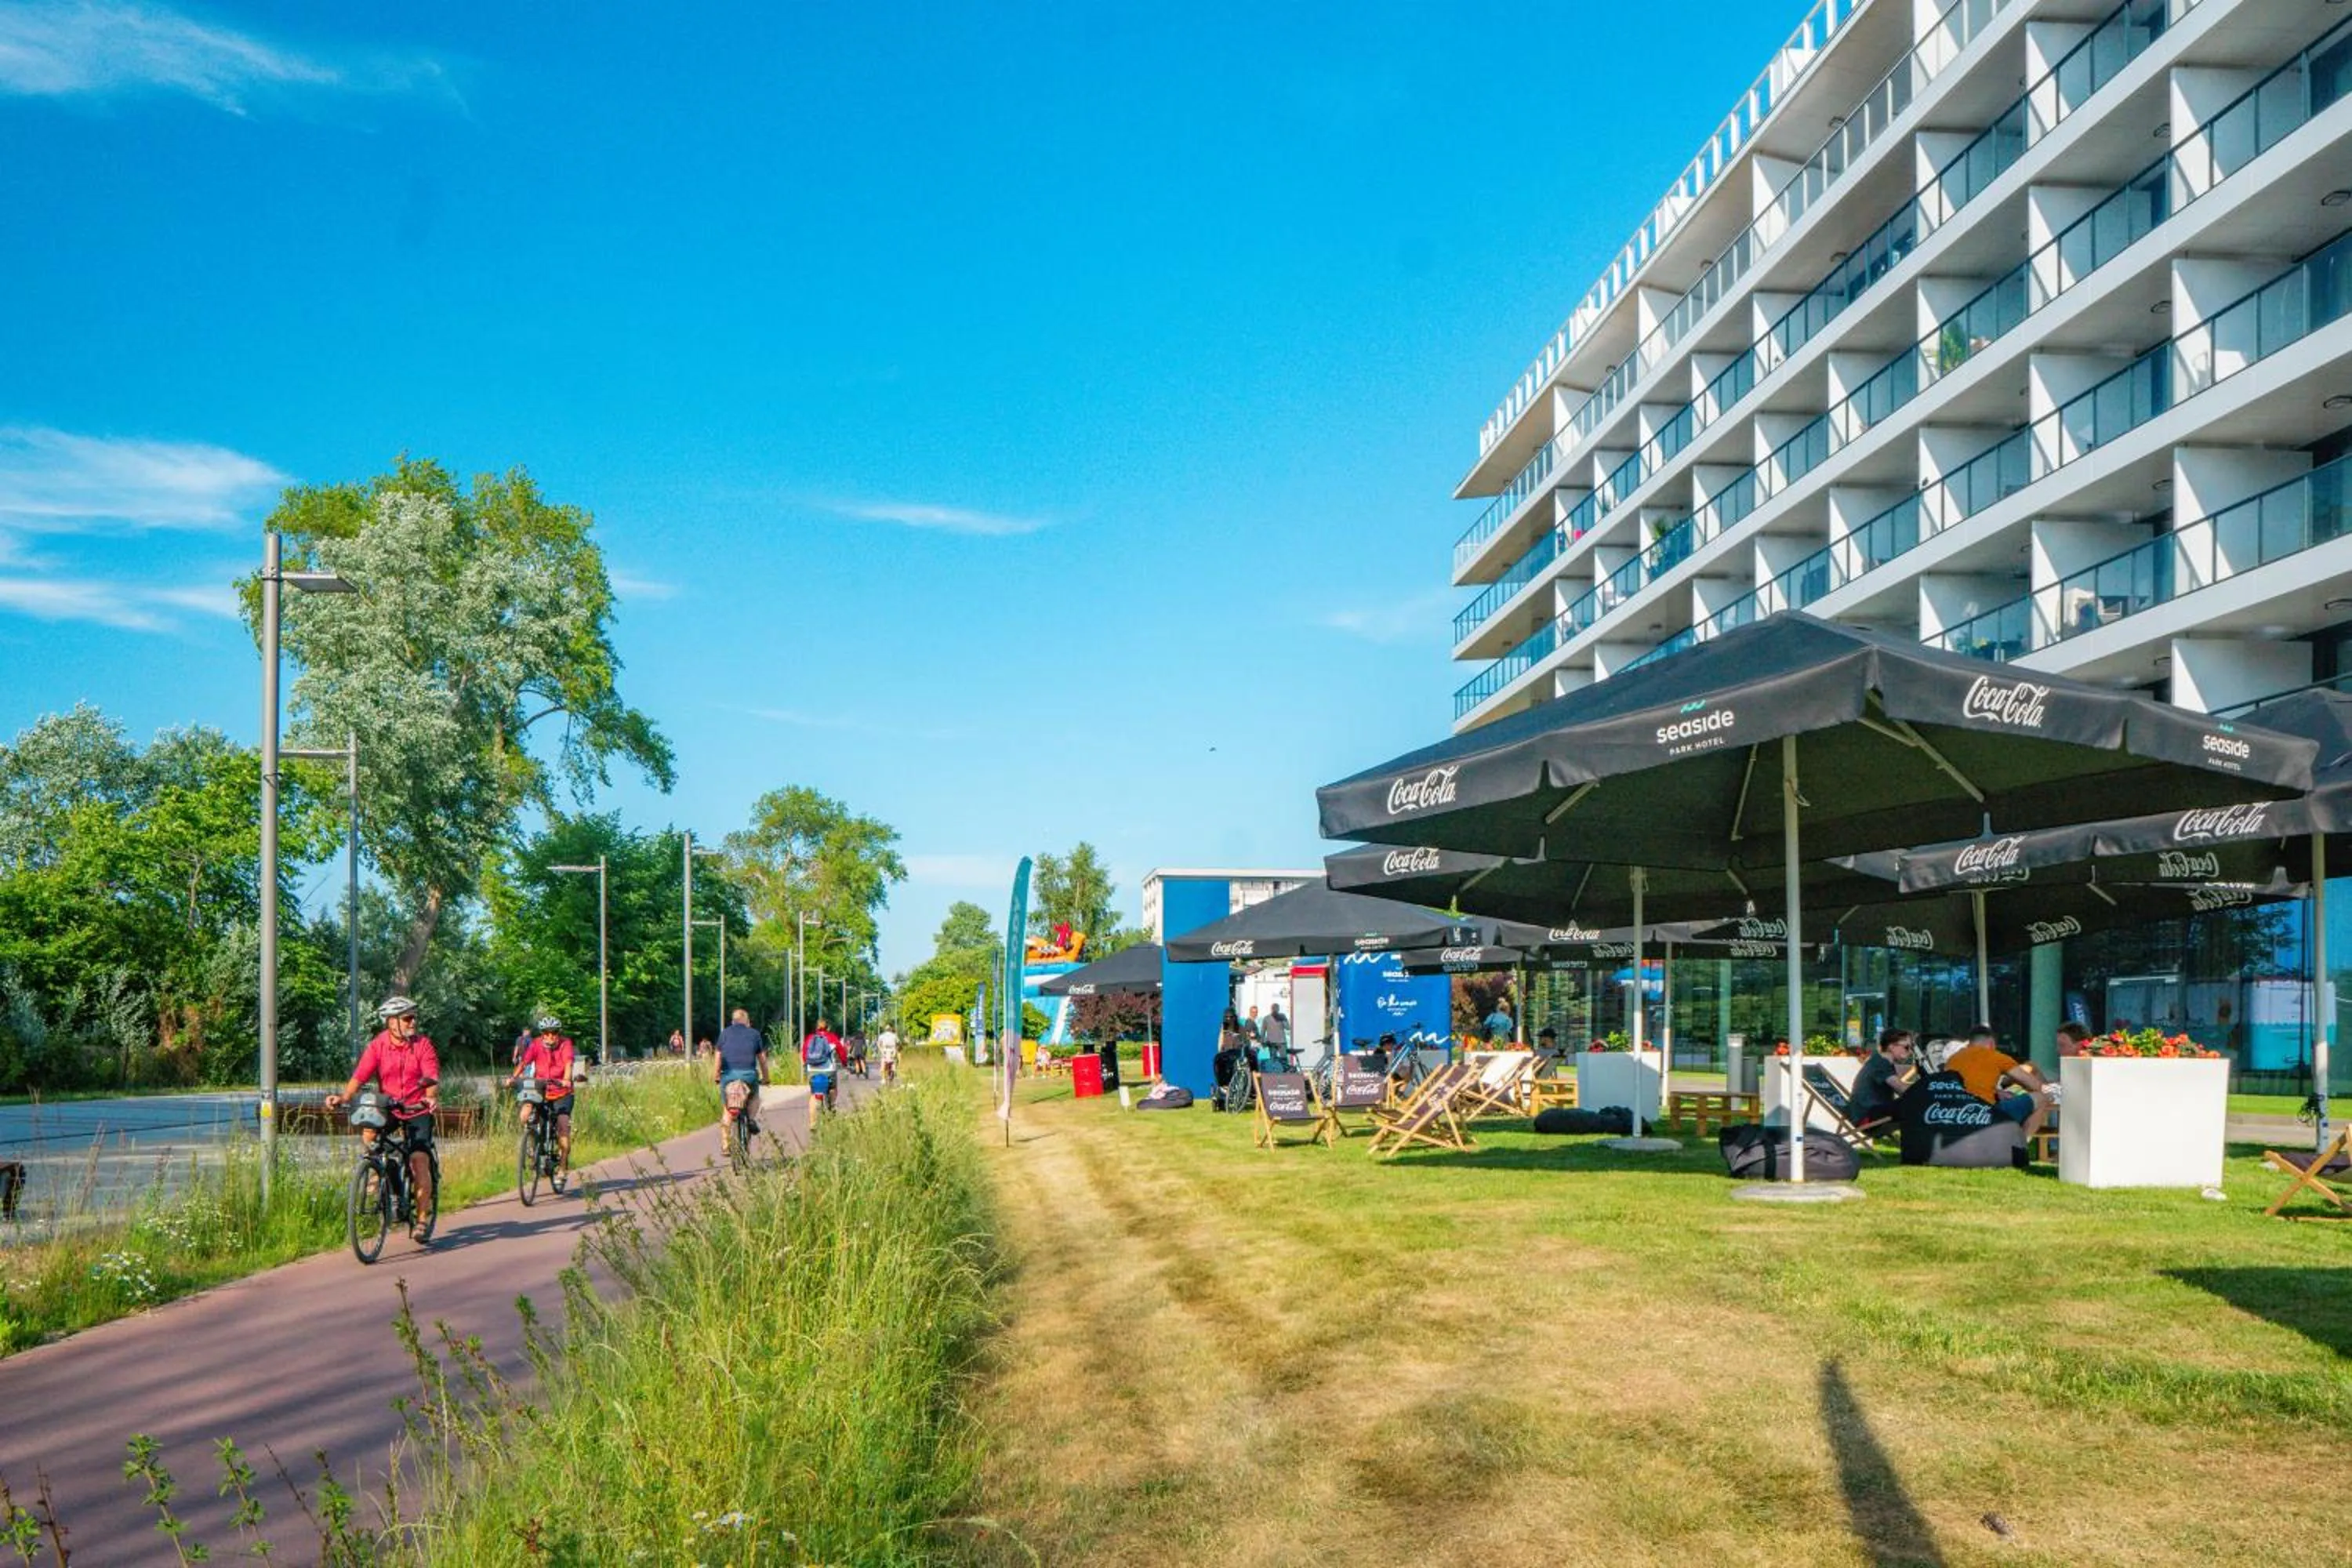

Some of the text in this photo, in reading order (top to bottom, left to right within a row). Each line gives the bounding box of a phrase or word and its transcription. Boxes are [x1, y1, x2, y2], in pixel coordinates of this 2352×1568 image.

[1963, 676, 2051, 728] Coca-Cola
[1657, 710, 1734, 743] seaside
[1669, 736, 1725, 757] PARK HOTEL
[2203, 734, 2250, 759] seaside
[1387, 765, 1459, 815] Coca-Cola
[2173, 801, 2274, 841] Coca-Cola
[1384, 847, 1439, 876] Coca-Cola
[1955, 835, 2027, 875] Coca-Cola
[1211, 940, 1254, 956] Coca-Cola
[1441, 946, 1483, 962] Coca-Cola
[1924, 1102, 1992, 1124] Coca-Cola
